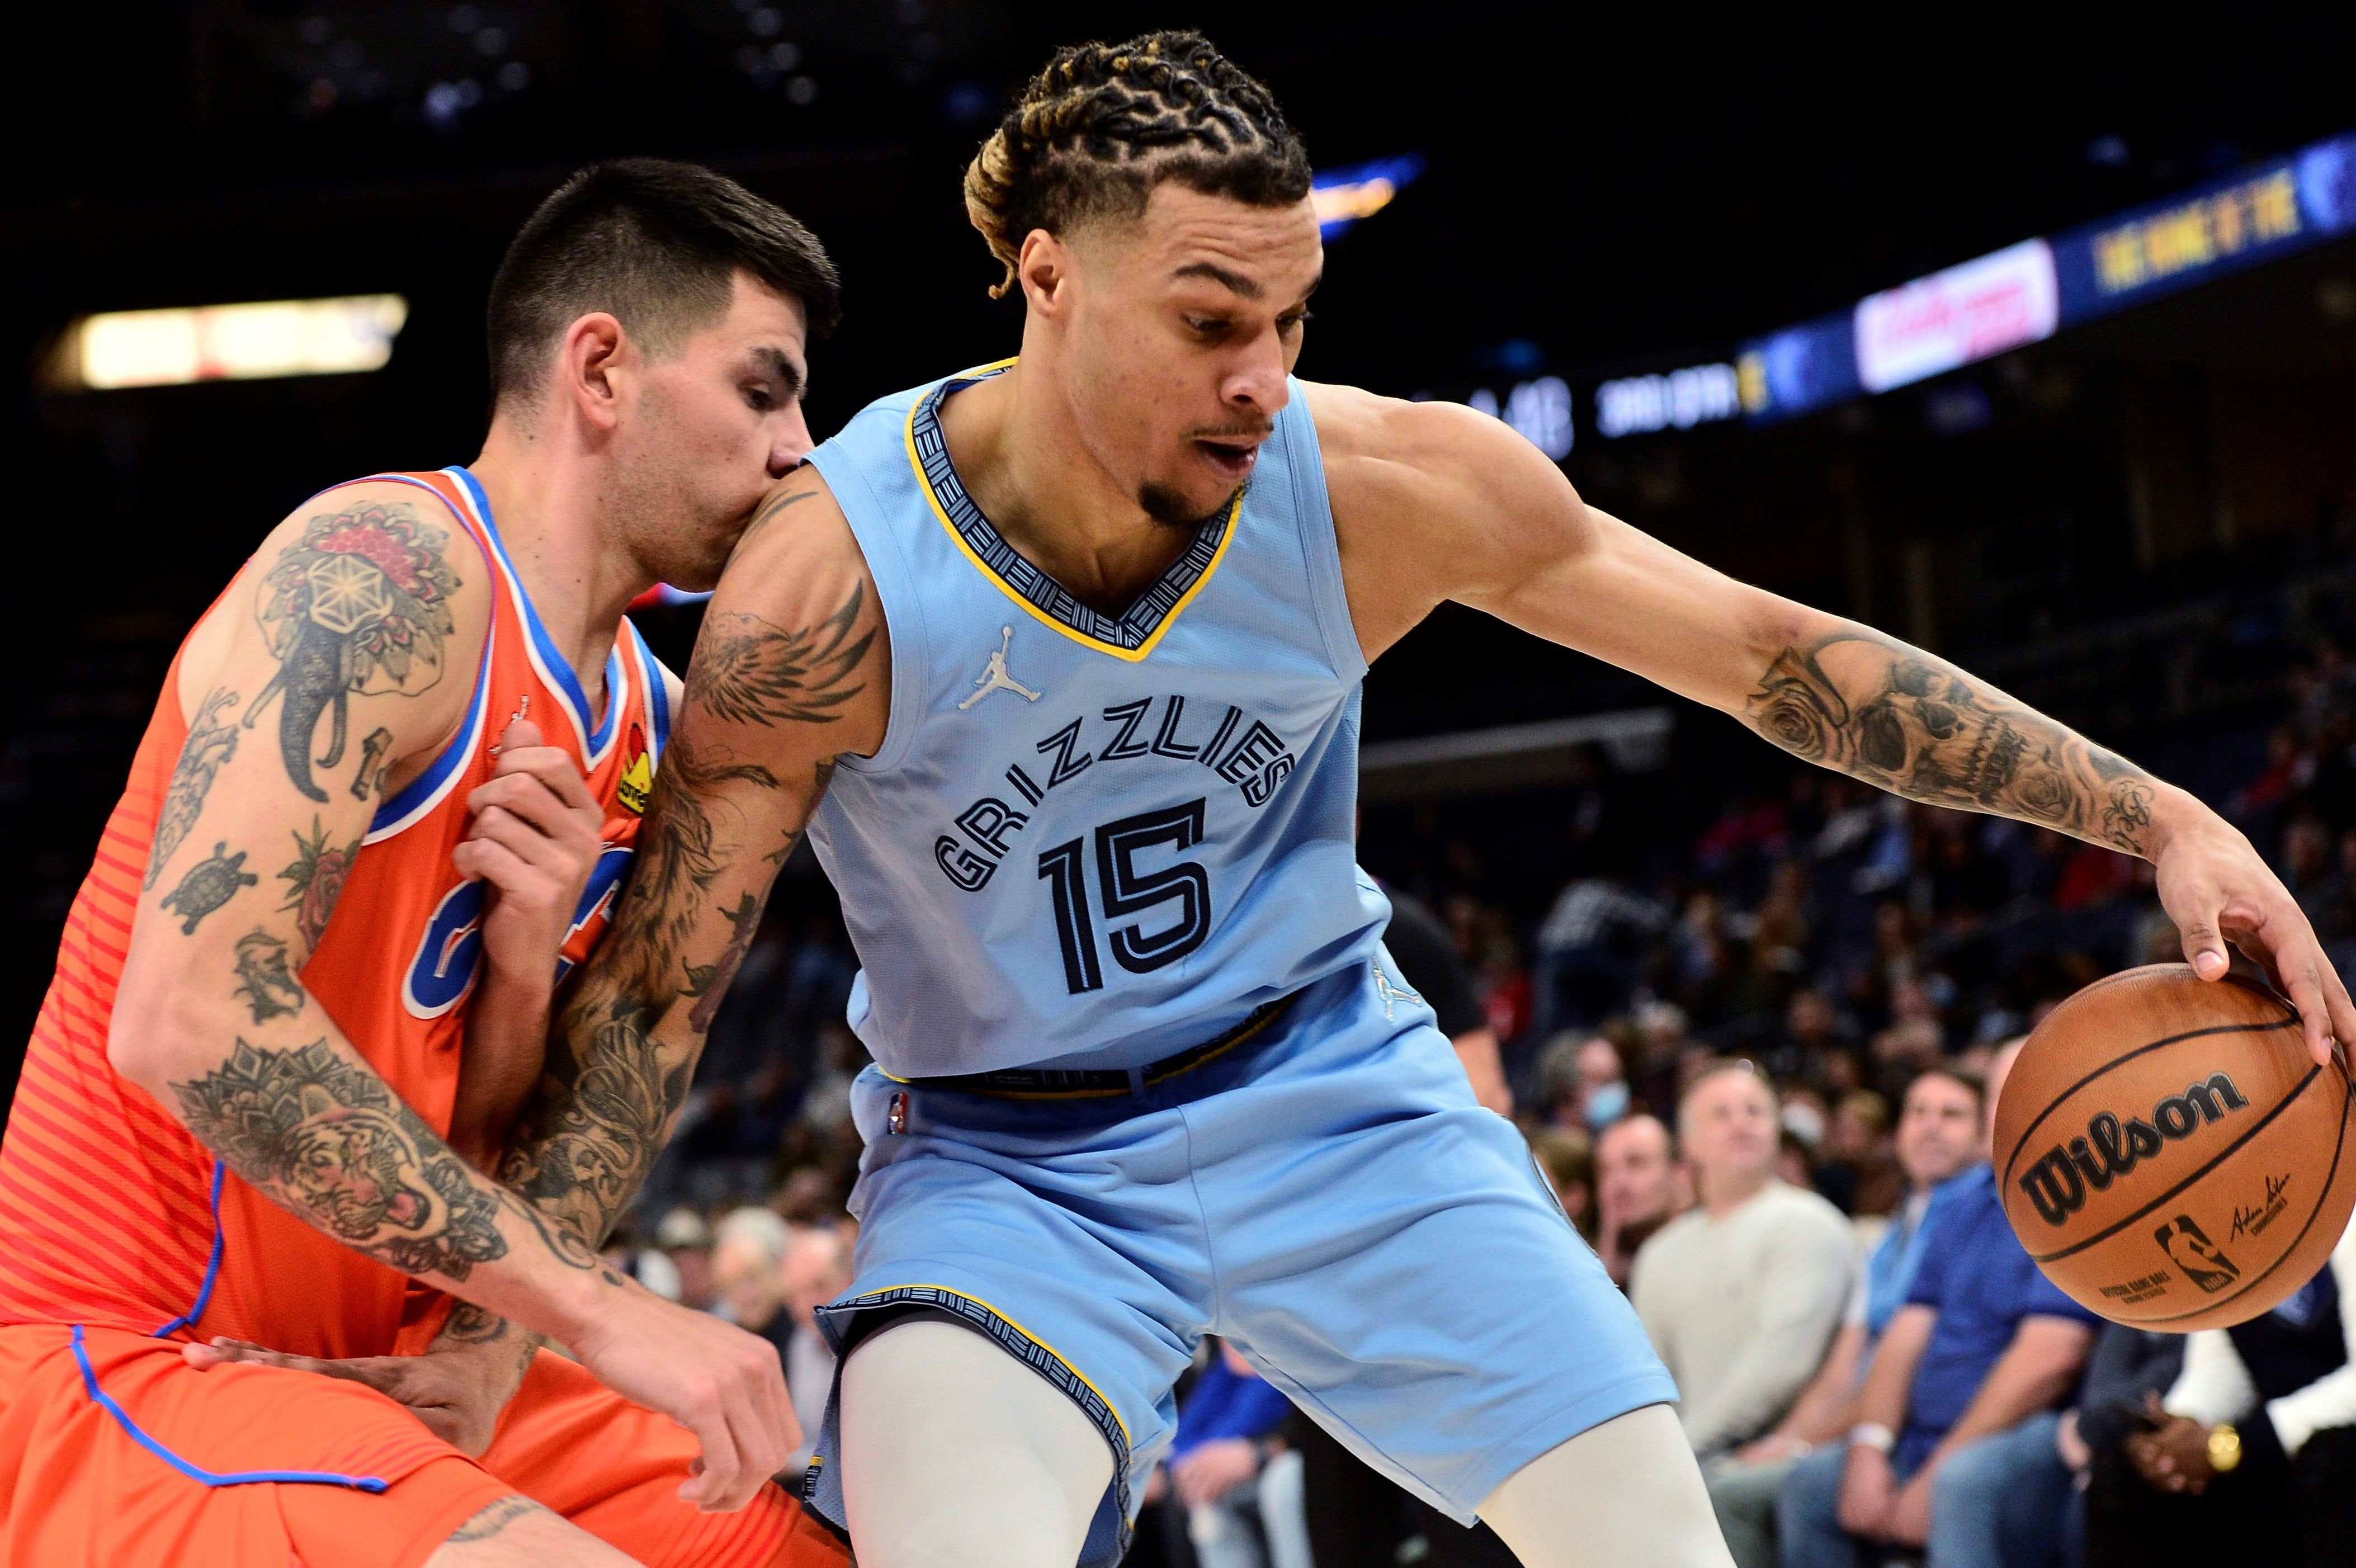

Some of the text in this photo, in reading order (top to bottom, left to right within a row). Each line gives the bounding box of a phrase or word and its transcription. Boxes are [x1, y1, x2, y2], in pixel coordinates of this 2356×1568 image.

[934, 695, 1296, 892] GRIZZLIES
[1038, 797, 1211, 994] 15
[2018, 1071, 2249, 1227] Wilson
